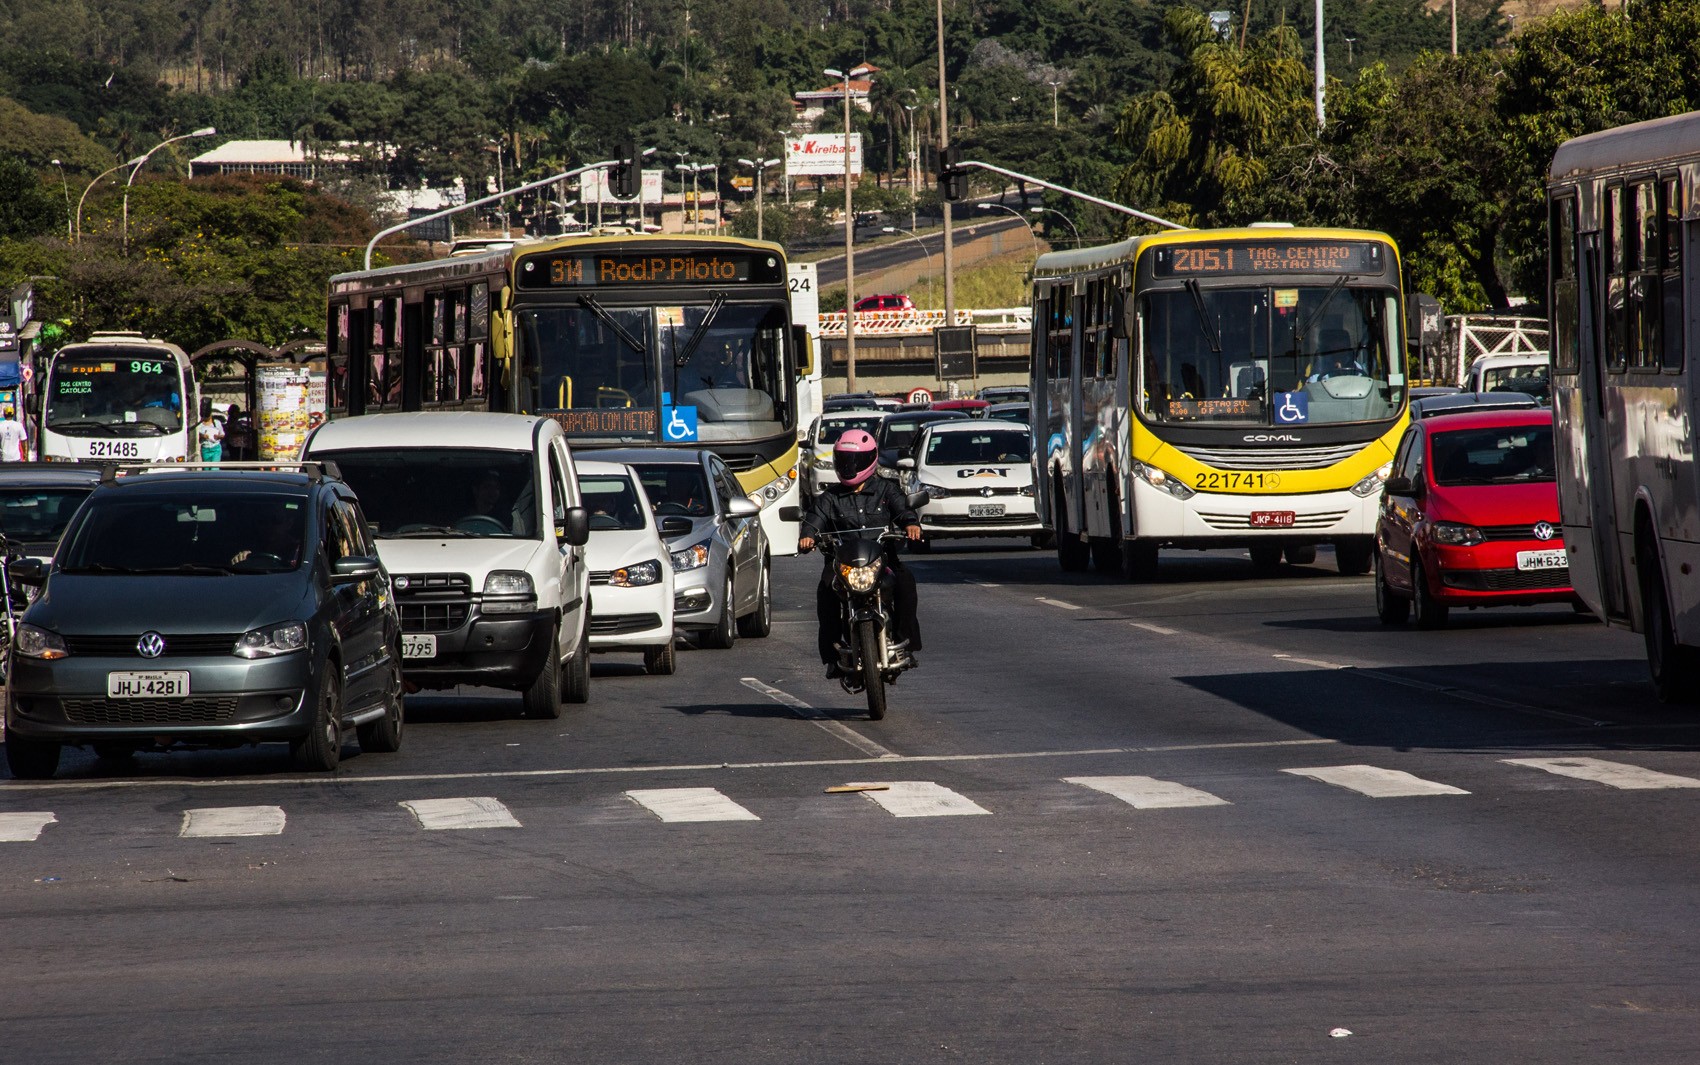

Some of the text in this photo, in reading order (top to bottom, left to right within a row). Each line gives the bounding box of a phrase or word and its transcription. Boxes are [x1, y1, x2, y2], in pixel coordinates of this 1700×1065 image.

[805, 141, 857, 153] Kireibaa
[1286, 246, 1350, 259] CENTRO
[552, 259, 582, 282] 314
[1313, 259, 1342, 269] SUL
[131, 361, 163, 374] 964
[913, 392, 929, 403] 60
[541, 411, 599, 433] EGRAÇÃO
[601, 412, 621, 431] COM
[1243, 434, 1301, 442] COMIL
[90, 441, 138, 457] 521485
[957, 468, 1011, 478] CAT
[1195, 473, 1264, 488] 221741
